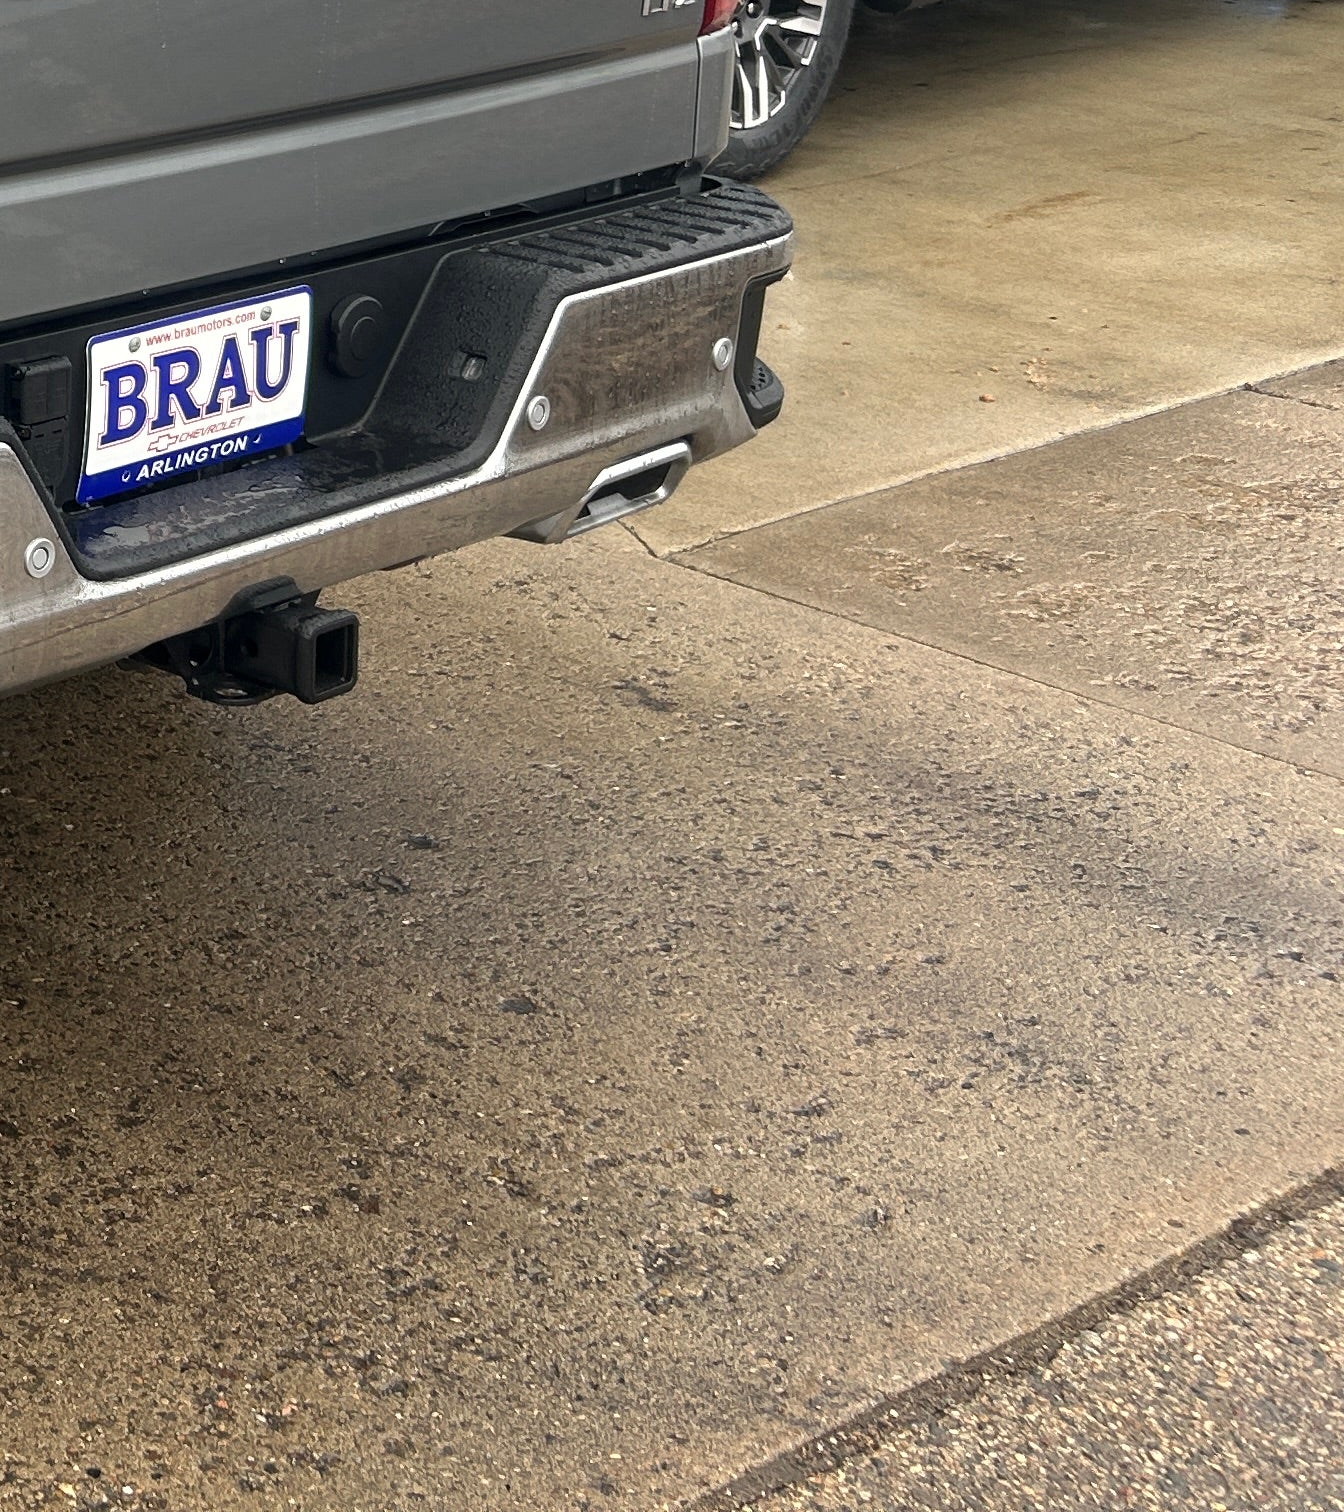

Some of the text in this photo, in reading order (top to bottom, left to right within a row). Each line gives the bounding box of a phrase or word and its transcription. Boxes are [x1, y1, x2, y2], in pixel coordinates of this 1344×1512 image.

[145, 311, 257, 347] www.braumotors.com
[97, 316, 301, 450] BRAU
[178, 415, 246, 443] CHEVROLET
[135, 435, 249, 482] ARLINGTON
